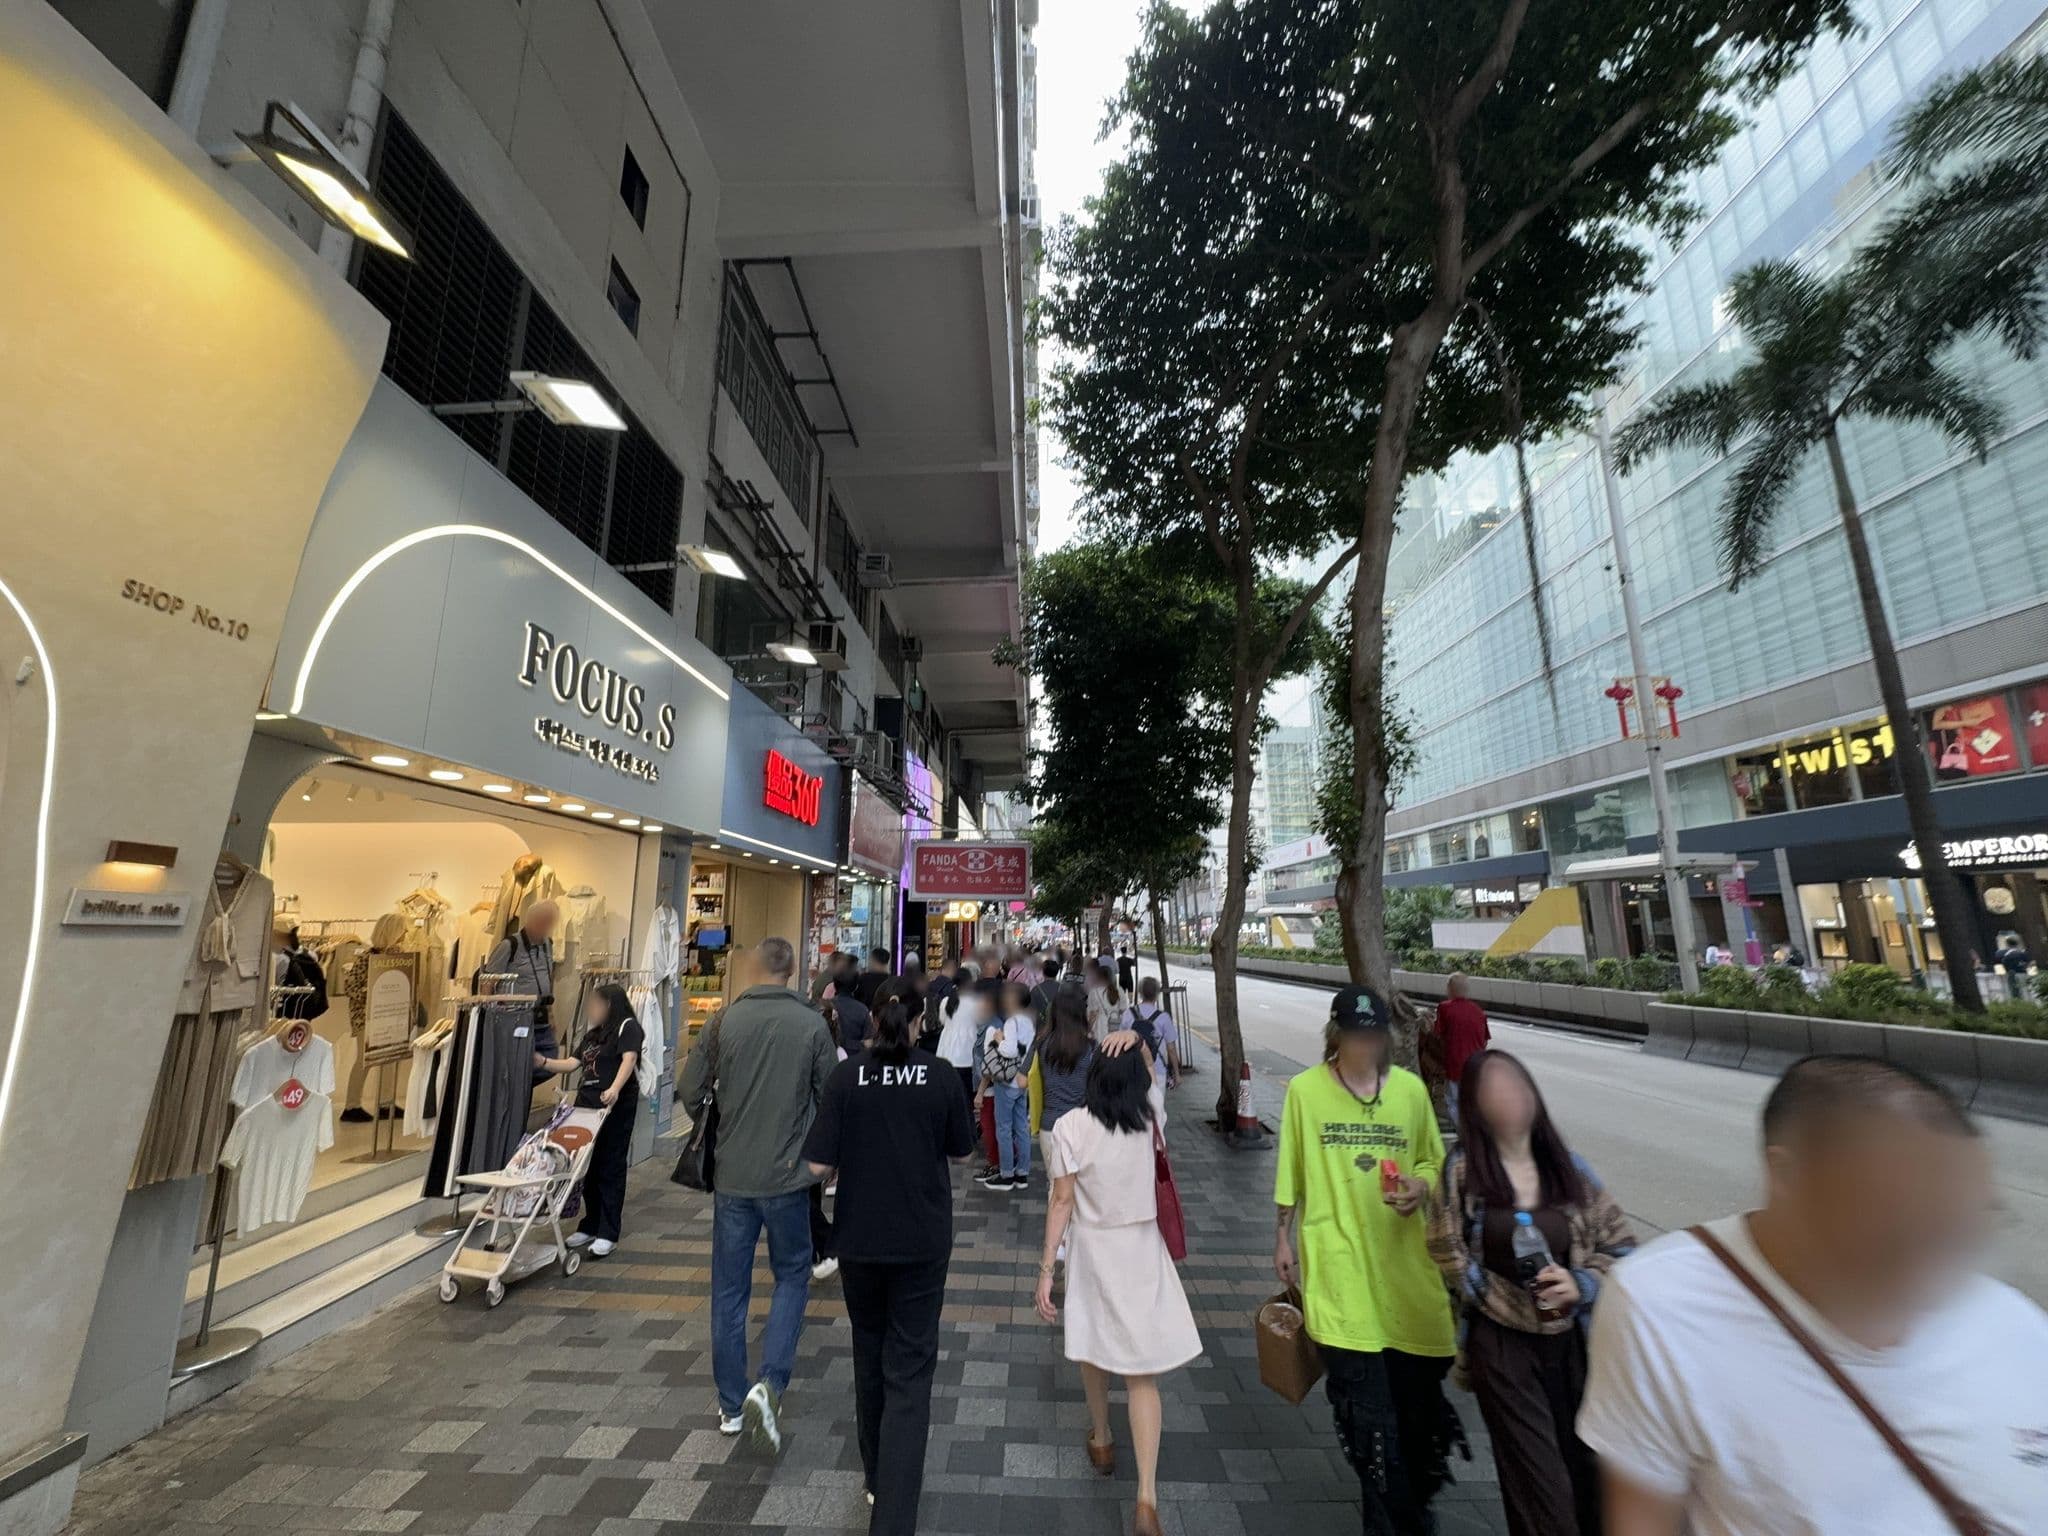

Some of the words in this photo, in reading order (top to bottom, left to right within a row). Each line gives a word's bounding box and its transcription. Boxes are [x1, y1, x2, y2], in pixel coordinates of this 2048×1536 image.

[121, 579, 185, 616] SHOP
[191, 604, 250, 641] No.10
[518, 620, 676, 751] FOCUS.S
[1773, 725, 1895, 778] twist
[922, 854, 958, 866] FANDA
[858, 1065, 928, 1086] LEWE
